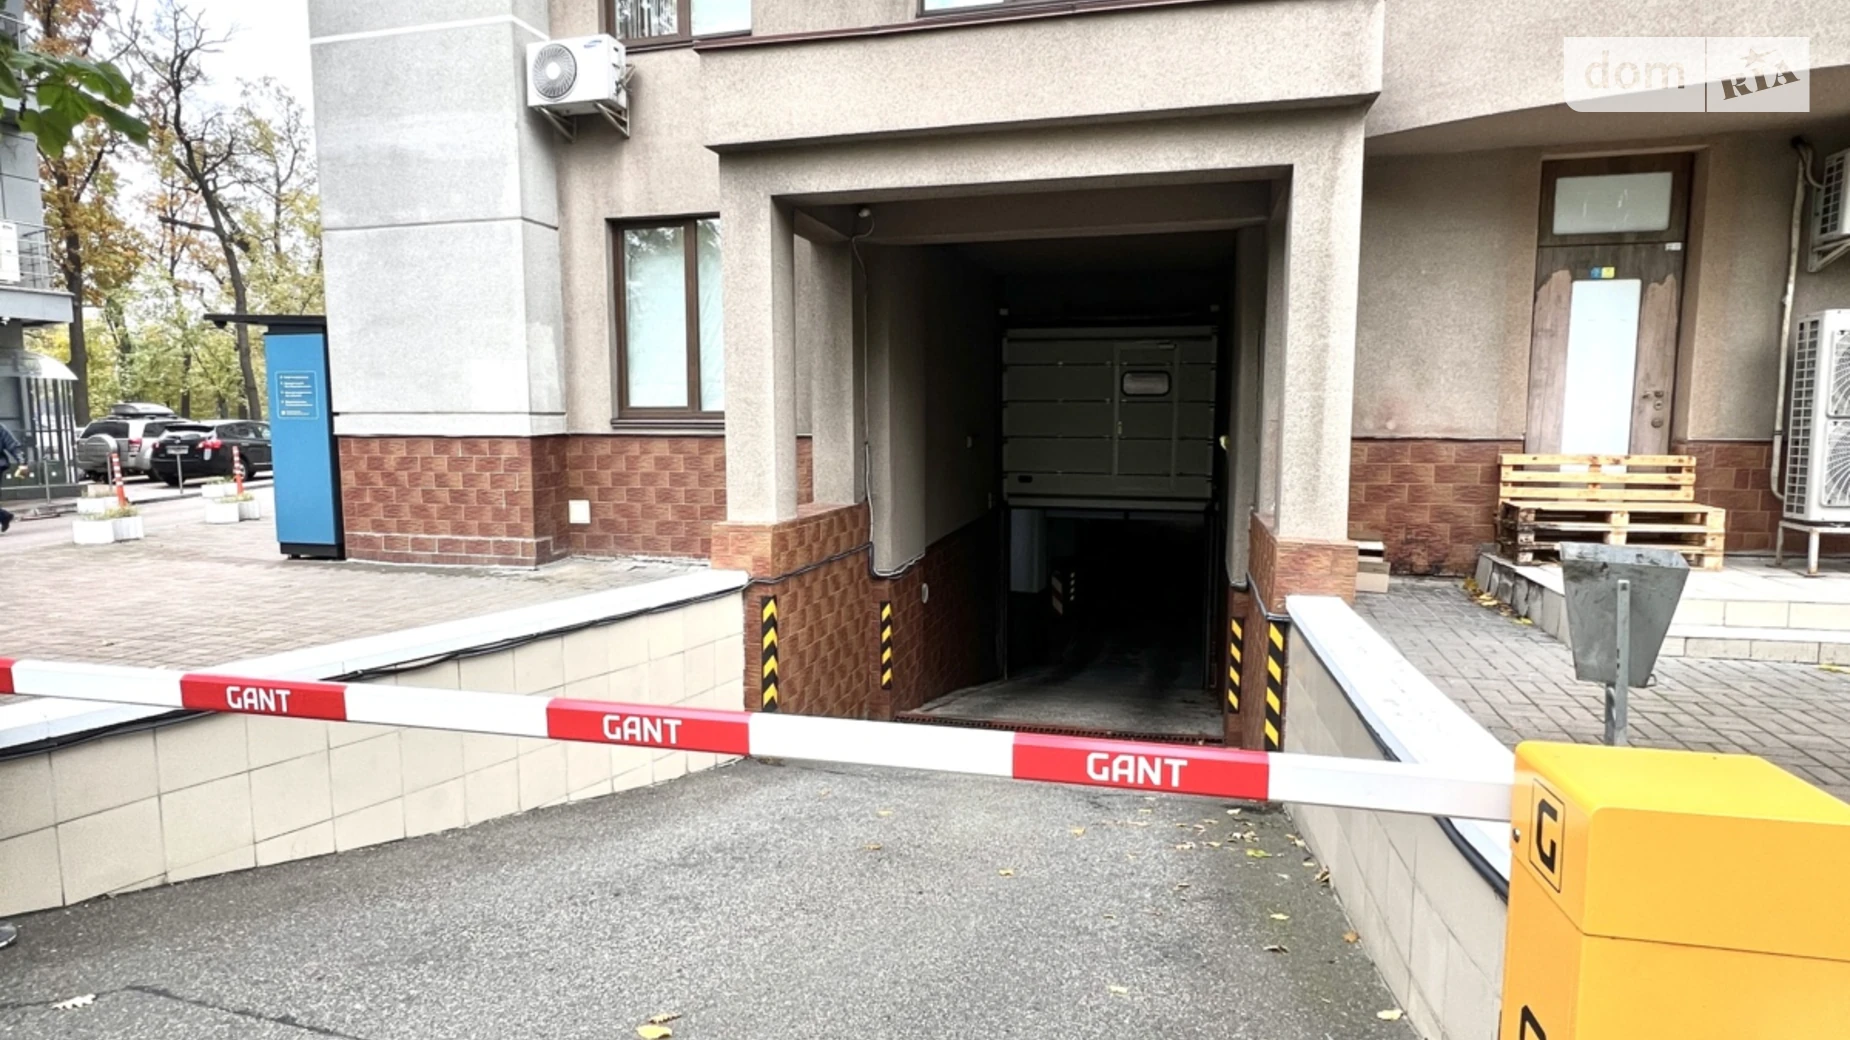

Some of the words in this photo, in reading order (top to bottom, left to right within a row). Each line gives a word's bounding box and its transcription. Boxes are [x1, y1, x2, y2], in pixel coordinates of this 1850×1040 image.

[226, 686, 291, 713] GANT
[602, 714, 682, 744] GANT
[1087, 752, 1188, 787] GANT
[1536, 798, 1558, 874] G
